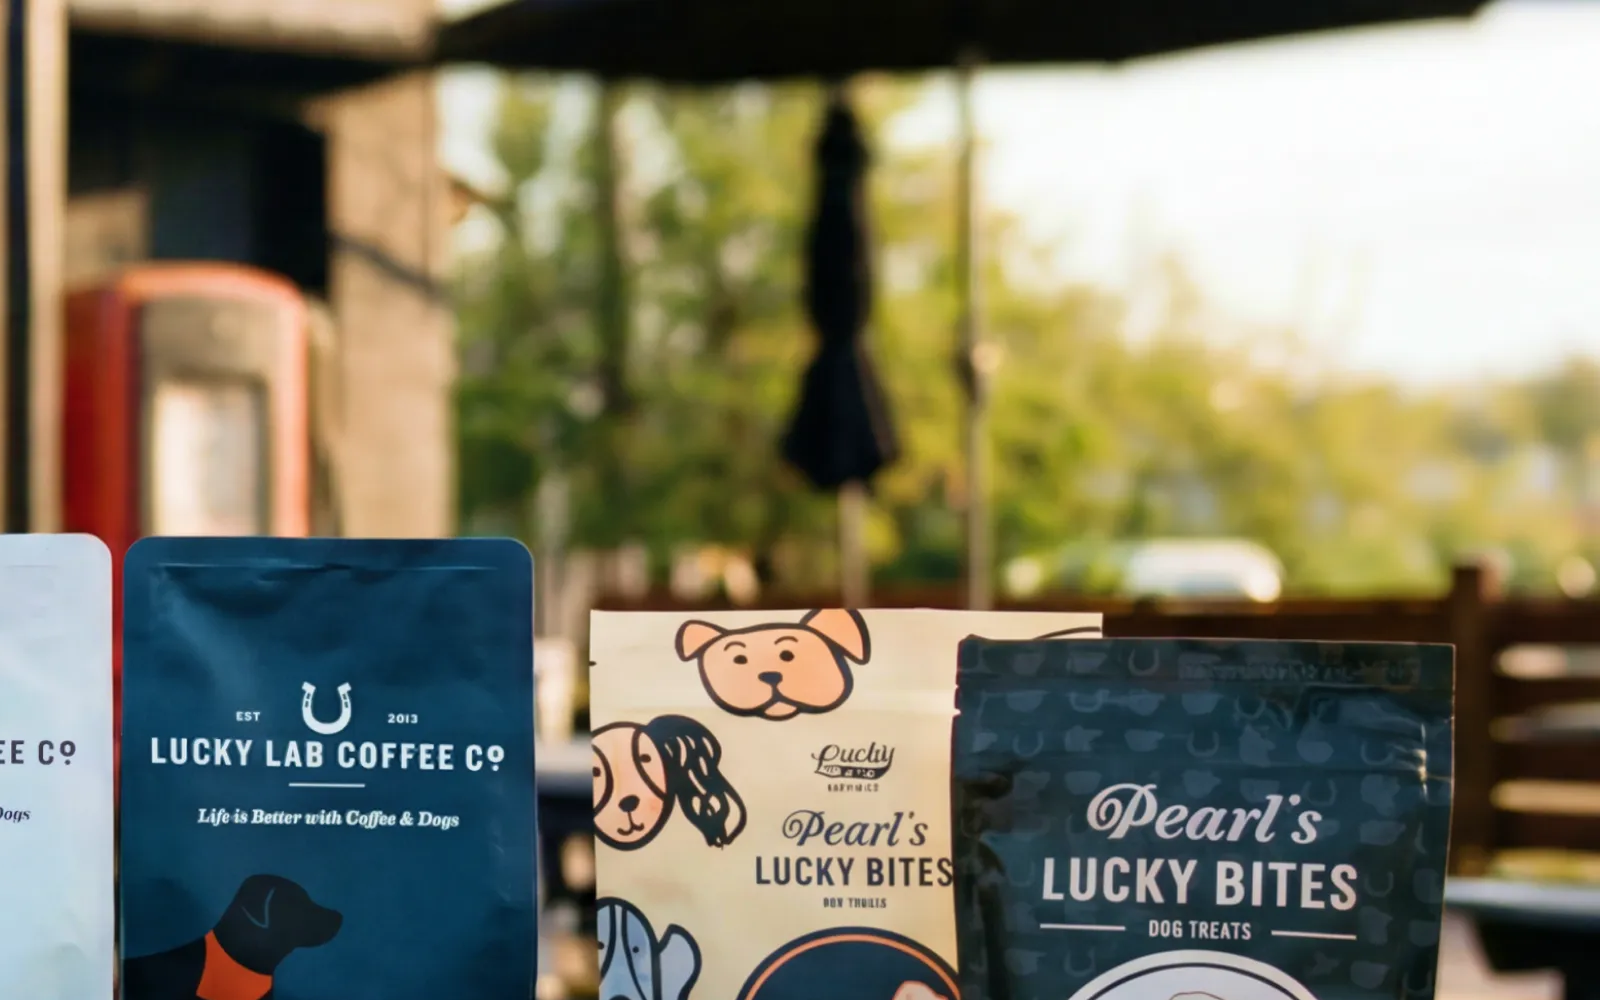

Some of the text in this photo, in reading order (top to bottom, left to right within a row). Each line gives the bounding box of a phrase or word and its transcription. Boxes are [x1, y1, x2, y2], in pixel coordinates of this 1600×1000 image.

[235, 711, 418, 724] EST 2013
[151, 737, 253, 766] LUCKY
[266, 739, 323, 768] LAB
[337, 741, 454, 770] COFFEE
[197, 808, 460, 830] Life is Better with Coffee & Dogs
[782, 809, 928, 847] Pearl's
[1086, 783, 1323, 845] Pearl's
[755, 855, 954, 887] LUCKY BITES
[1042, 856, 1358, 911] LUCKY BITES
[1148, 919, 1252, 941] DOG TREATS
